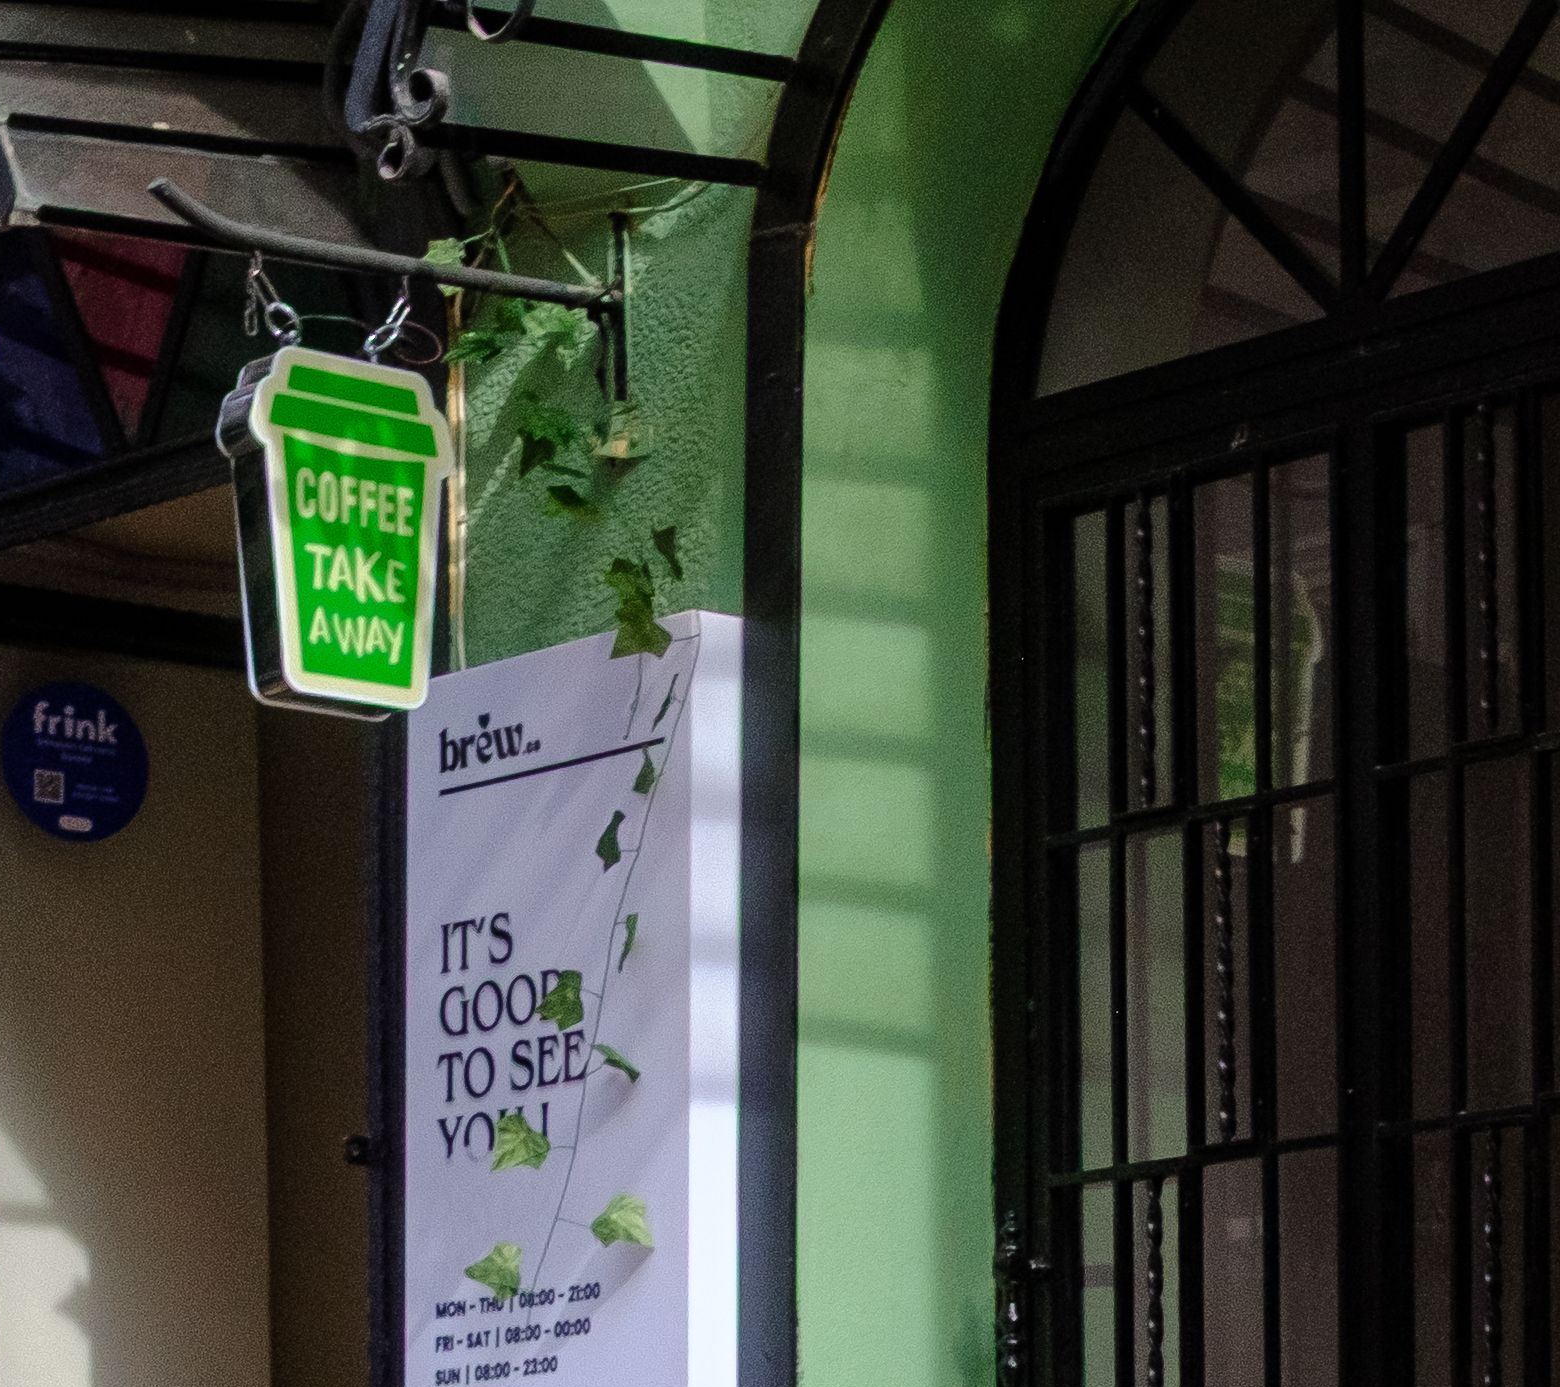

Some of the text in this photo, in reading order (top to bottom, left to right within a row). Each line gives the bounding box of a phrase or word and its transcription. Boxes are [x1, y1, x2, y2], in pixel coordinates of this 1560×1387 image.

[296, 467, 414, 537] COFFEE
[304, 543, 406, 604] TAKE
[308, 605, 405, 665] AWAY
[32, 699, 118, 745] frink
[440, 912, 513, 974] IT'S
[437, 1030, 588, 1102] TO SEE
[435, 1301, 466, 1319] MON
[479, 1296, 504, 1313] THU
[435, 1335, 454, 1353] FRI
[466, 1330, 490, 1348] SAT
[554, 1317, 591, 1338] 00:00
[435, 1368, 461, 1386] SUN
